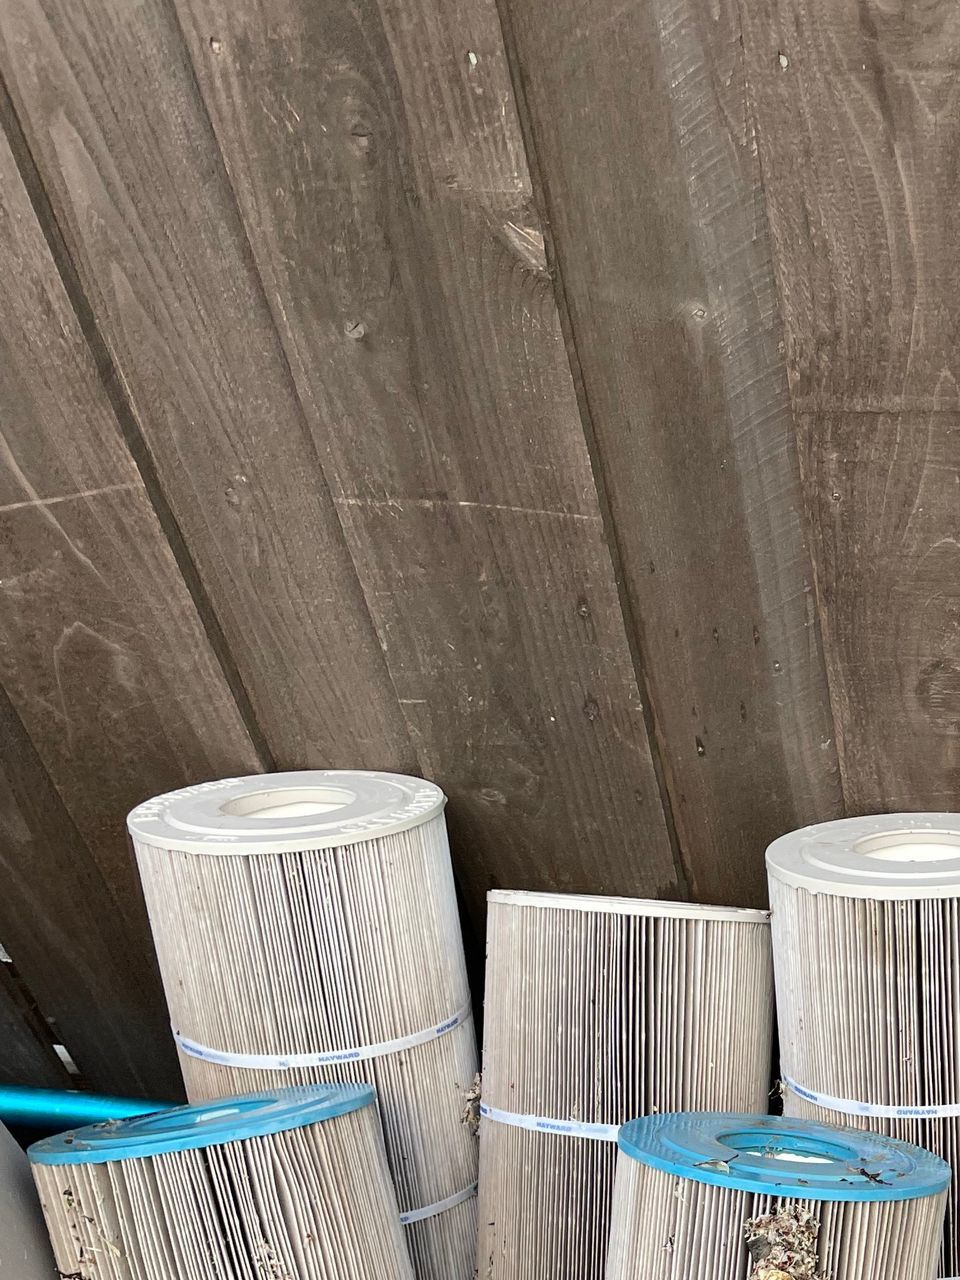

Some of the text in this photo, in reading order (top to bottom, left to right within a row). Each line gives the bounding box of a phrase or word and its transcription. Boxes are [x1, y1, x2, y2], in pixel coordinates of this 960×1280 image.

[436, 1018, 459, 1034] HAYWARD
[318, 1051, 360, 1063] HAYWARD
[536, 1121, 573, 1132] HAYWARD
